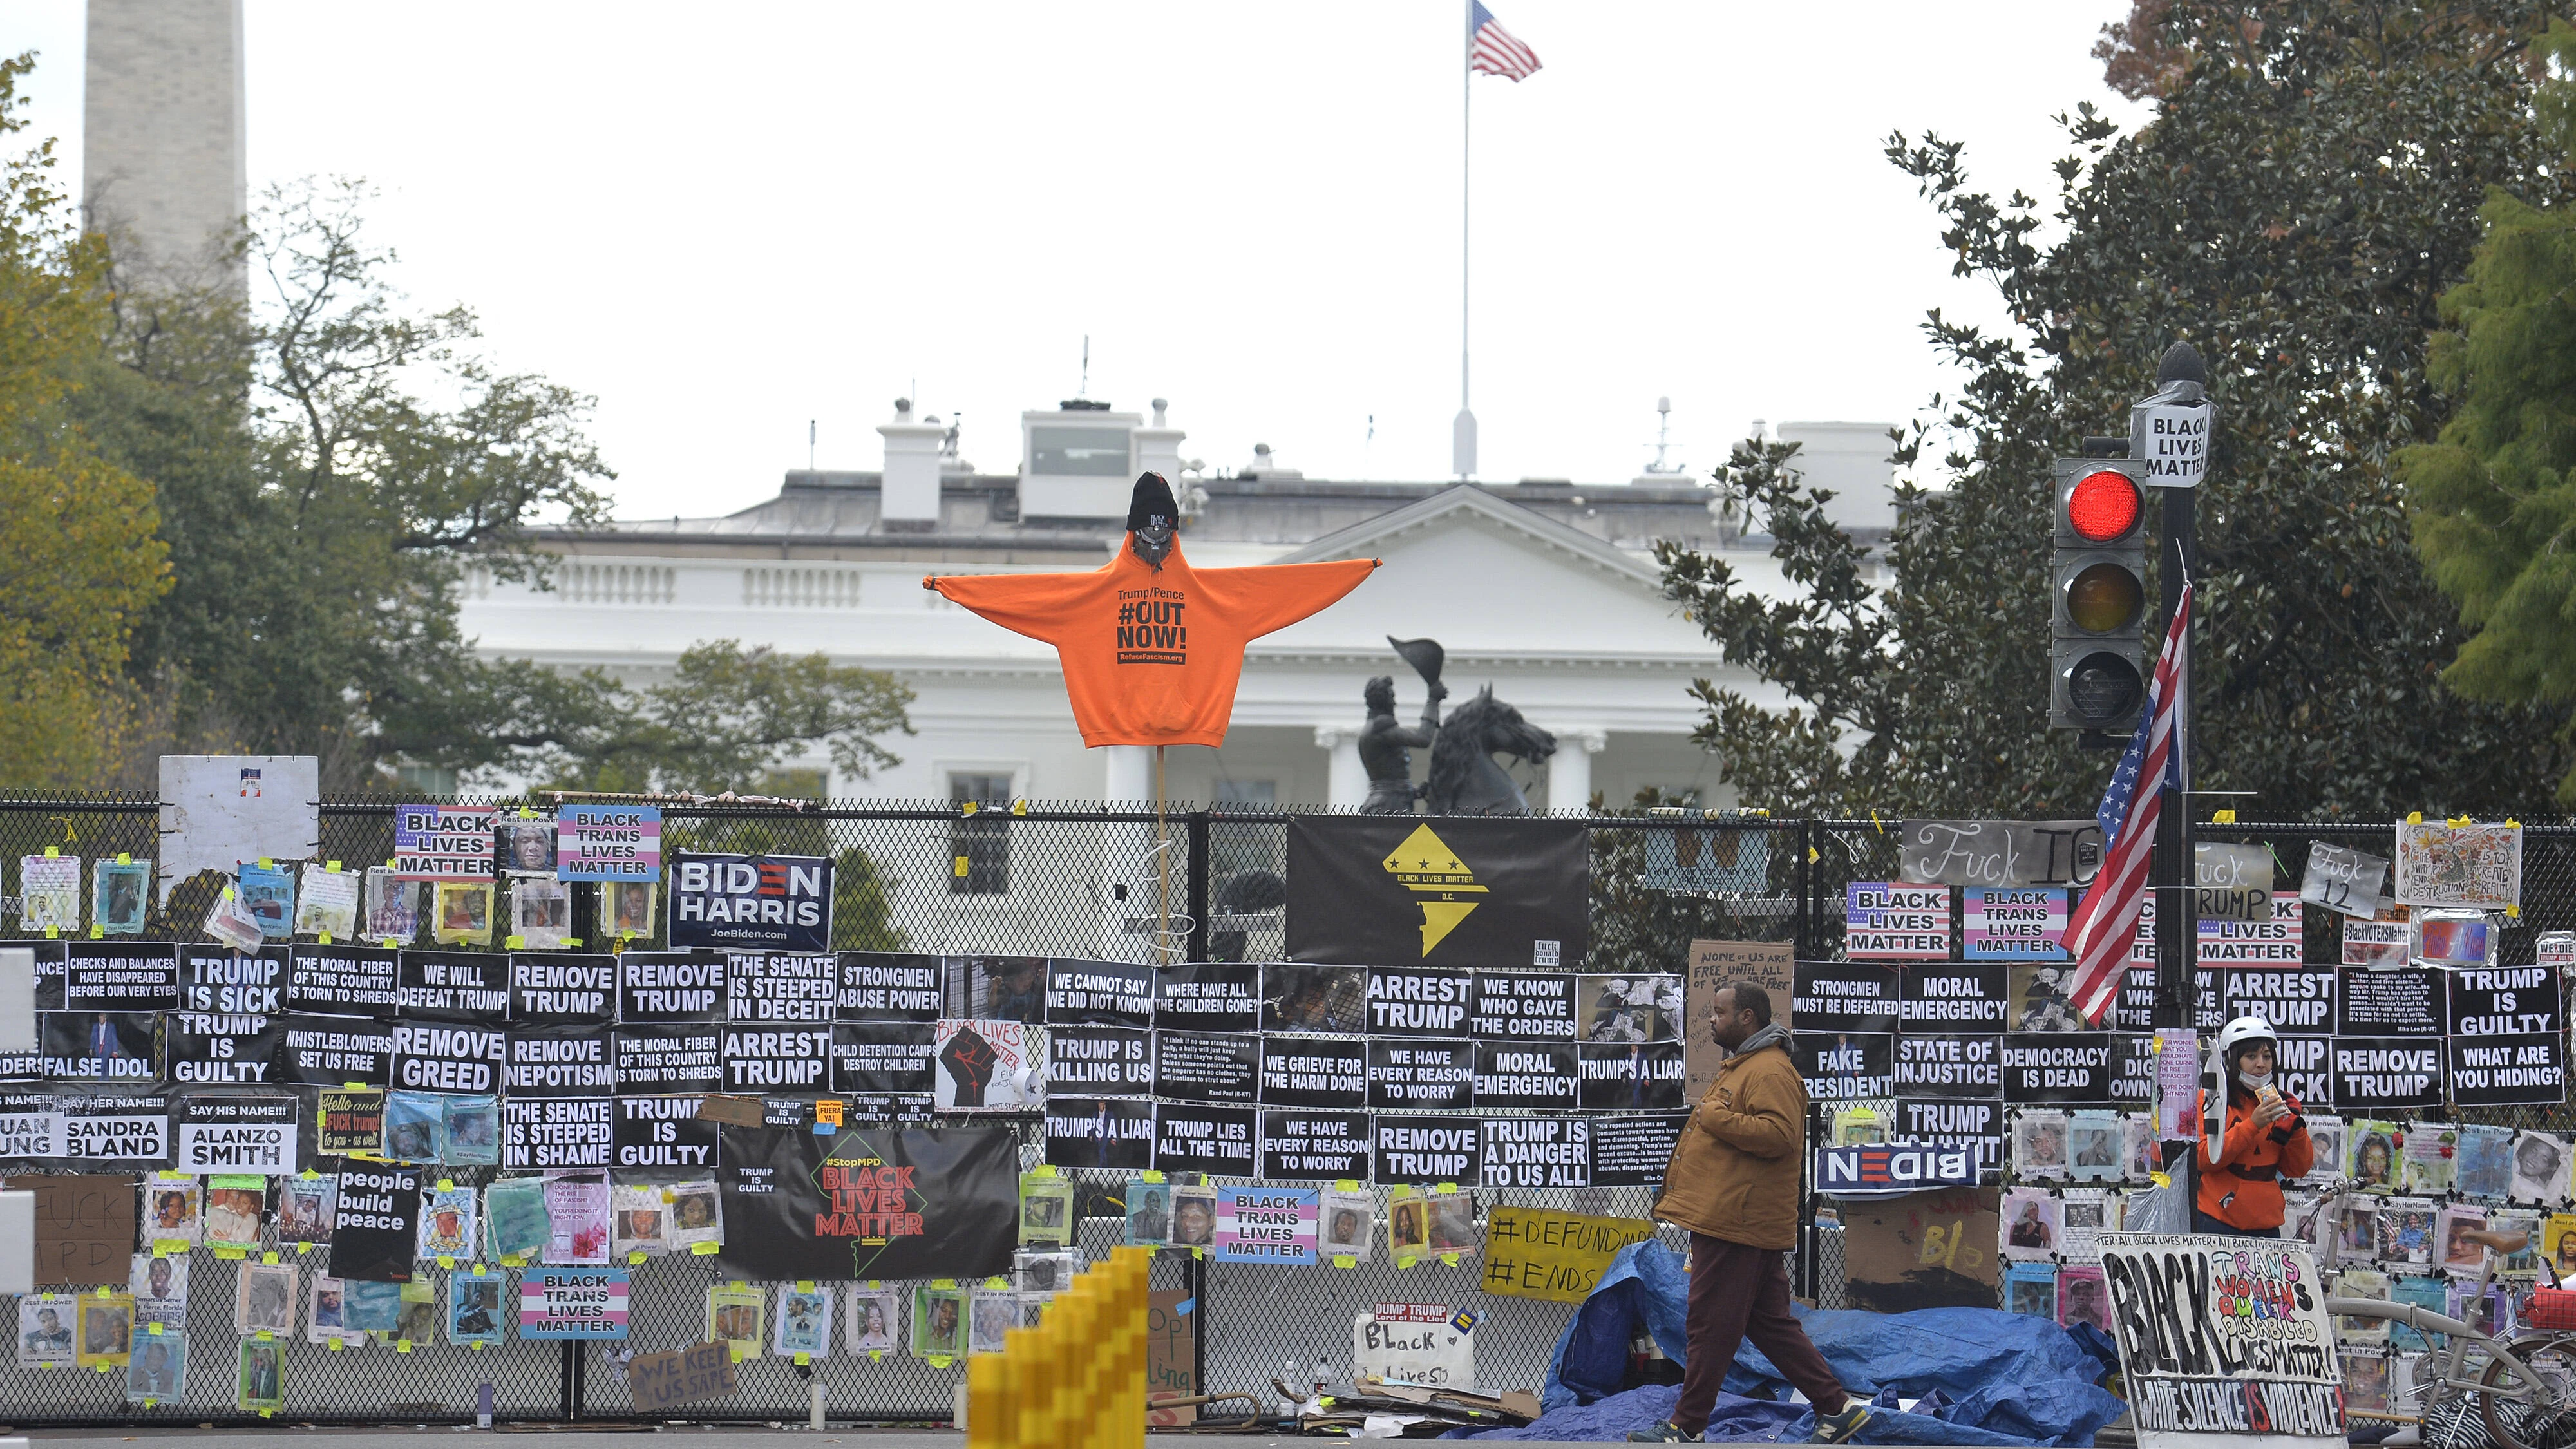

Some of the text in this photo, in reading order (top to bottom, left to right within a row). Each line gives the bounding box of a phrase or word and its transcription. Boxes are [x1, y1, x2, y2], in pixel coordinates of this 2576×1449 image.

[2154, 417, 2204, 435] BLACK
[2159, 439, 2202, 455] LIVES
[2146, 457, 2204, 477] MATTER
[1118, 587, 1184, 600] Trump/Pence
[1119, 601, 1185, 625] #OUT
[1117, 625, 1186, 649] NOW!
[1120, 654, 1182, 662] RefuseFascism.org
[406, 814, 491, 832] BLACK
[418, 838, 484, 853] LIVES
[399, 858, 494, 874] MATTER
[2311, 844, 2363, 884] Fuck
[2420, 853, 2429, 862] THE
[2483, 851, 2505, 864] IS TO
[2416, 864, 2440, 875] WAY TO
[2479, 867, 2508, 883] CREATE
[681, 862, 820, 897] BIDEN
[2415, 875, 2427, 886] END
[2319, 878, 2354, 911] 12
[2414, 884, 2465, 899] DESTRUCTION
[2481, 881, 2512, 898] BEAUTY
[679, 897, 819, 927] HARRIS
[711, 929, 788, 940] JoeBiden.com
[2345, 925, 2408, 942] #BlackVOTERSMatter
[1538, 942, 1557, 951] fuck
[2541, 944, 2573, 953] WE DIE
[70, 958, 175, 971] CHECKS AND BALANCES
[1535, 956, 1558, 965] trump
[80, 972, 166, 983] HAVE DISAPPEARED
[190, 958, 279, 985] TRUMP
[424, 965, 484, 987] WE WILL
[70, 985, 176, 997] BEFORE OUR VERY EYES
[1484, 979, 1564, 996] WE KNOW
[188, 987, 280, 1012] IS SICK
[399, 988, 506, 1009] DEFEAT TRUMP
[1480, 998, 1567, 1016] WHO GAVE
[1472, 1017, 1575, 1036] THE ORDERS
[1901, 1041, 1992, 1062] STATE OF
[2463, 1046, 2549, 1066] WHAT ARE
[44, 1058, 153, 1077] FALSE IDOL
[1497, 1054, 1555, 1073] MORAL
[1580, 1061, 1683, 1079] TRUMP'S A LIAR
[1895, 1063, 1998, 1084] INJUSTICE
[2454, 1066, 2561, 1088] YOU HIDING?
[1474, 1076, 1577, 1097] EMERGENCY
[63, 1097, 164, 1108] SAY HER NAME!!!
[189, 1106, 287, 1115] SAY HIS NAME!!!
[323, 1095, 381, 1112] Hello and
[67, 1122, 159, 1137] SANDRA
[325, 1113, 379, 1132] #FUCK trump!
[192, 1129, 282, 1144] ALANZO
[325, 1134, 379, 1148] to you as well,
[66, 1139, 160, 1156] BLAND
[191, 1146, 282, 1166] SMITH
[826, 1157, 881, 1167] #StopMPD
[340, 1172, 415, 1192] people
[822, 1166, 914, 1189] BLACK
[339, 1193, 393, 1212] build
[832, 1189, 906, 1213] LIVES
[336, 1213, 404, 1231] peace
[815, 1213, 924, 1236] MATTER
[2212, 1251, 2299, 1282] TRANS
[544, 1276, 609, 1287] BLACK
[544, 1291, 608, 1302] TRANS
[548, 1305, 604, 1317] LIVES
[1376, 1303, 1446, 1314] DUMP TRUMP
[2102, 1252, 2236, 1376] BLACK
[2219, 1296, 2295, 1322] QUEER
[536, 1320, 615, 1332] MATTER
[2221, 1314, 2317, 1342] DISABLED
[638, 1345, 728, 1381] WE KEEP
[657, 1369, 734, 1403] US SAFE
